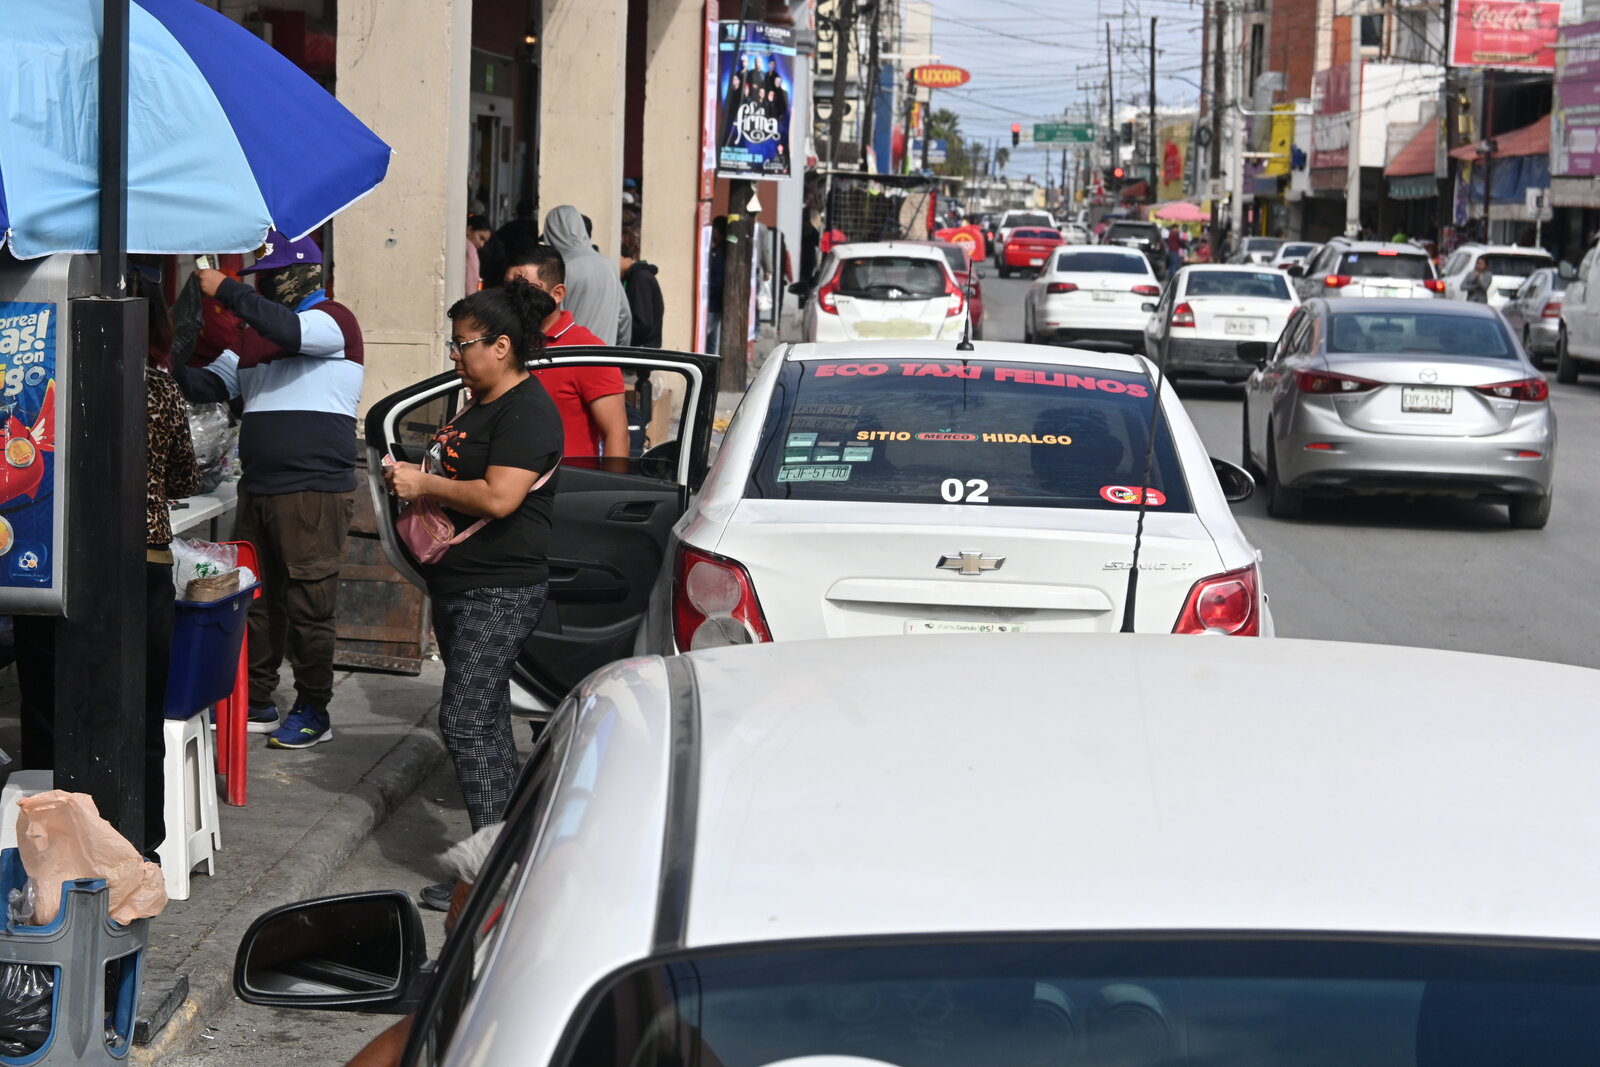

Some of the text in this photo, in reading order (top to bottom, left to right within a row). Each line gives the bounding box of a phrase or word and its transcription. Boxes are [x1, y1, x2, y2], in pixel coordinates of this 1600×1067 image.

[913, 68, 962, 84] LUXOR
[12, 351, 45, 366] con
[813, 362, 1149, 399] ECO TAXI FELINOS
[1404, 394, 1450, 409] EUY-512-C
[856, 430, 1073, 446] SITIO MERCO HIDALGO
[940, 478, 989, 503] 02
